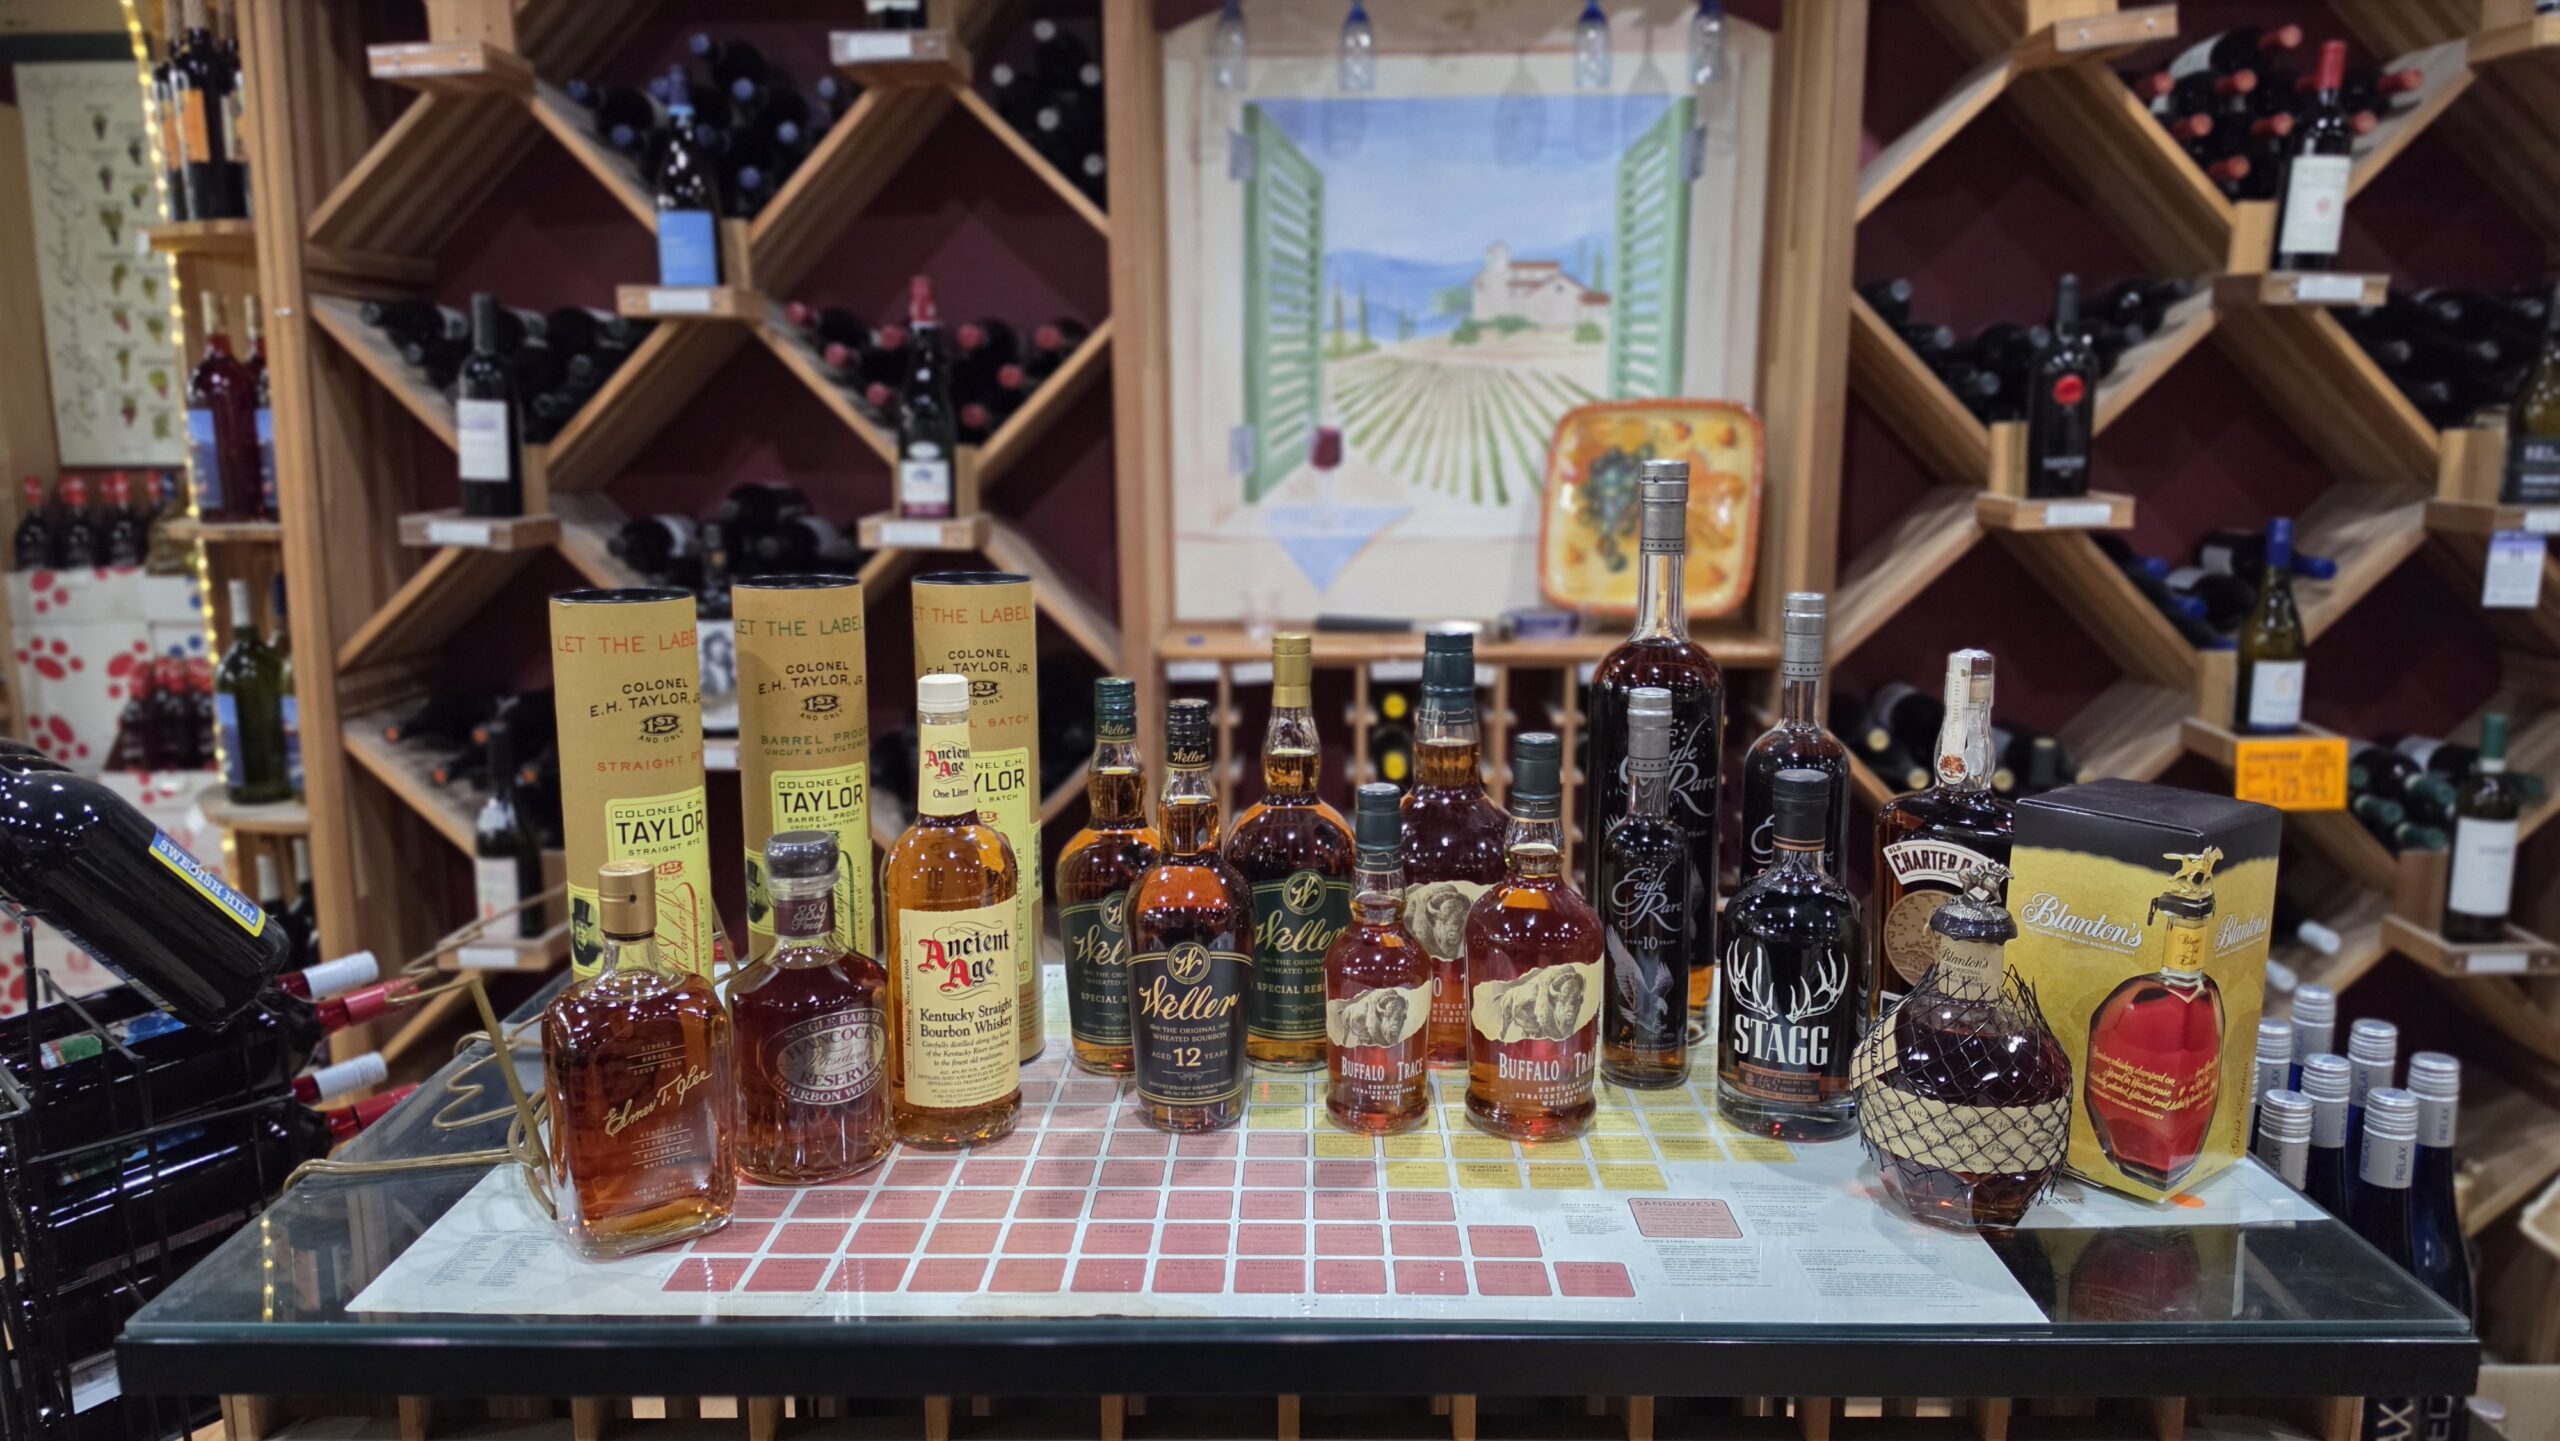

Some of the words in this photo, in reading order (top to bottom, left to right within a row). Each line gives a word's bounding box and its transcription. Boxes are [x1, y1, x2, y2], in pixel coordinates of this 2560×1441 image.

[932, 607, 968, 624] THE
[980, 606, 1030, 623] LABEL
[766, 620, 807, 637] THE
[557, 635, 585, 653] LET
[598, 635, 645, 654] THE
[948, 649, 1011, 660] COLONEL
[785, 661, 849, 675] COLONEL
[953, 661, 1012, 674] TAYLOR,
[621, 678, 689, 695] COLONEL
[758, 680, 786, 695] E.H.
[791, 674, 851, 688] TAYLOR,
[590, 701, 622, 717] E.H.
[628, 692, 691, 709] TAYLOR,
[983, 695, 1003, 706] ONLY
[800, 712, 818, 721] AND
[823, 709, 843, 721] ONLY
[988, 715, 1029, 728] BATCH
[1100, 720, 1131, 735] Weller
[638, 735, 659, 744] AND
[663, 729, 684, 743] ONLY
[761, 735, 824, 746] BARREL
[765, 747, 800, 756] UNCUT
[805, 748, 812, 756] &
[925, 746, 970, 769] Ancient
[1172, 746, 1206, 763] Weller
[597, 755, 683, 772] STRAIGHT
[935, 761, 964, 780] Age
[1004, 759, 1024, 769] E.H.
[778, 778, 840, 789] COLONEL
[974, 768, 1025, 793] YLOR
[779, 784, 864, 813] TAYLOR
[933, 789, 949, 798] One
[952, 788, 968, 798] Liter
[989, 794, 1018, 803] BATCH
[615, 804, 683, 819] COLONEL
[788, 815, 827, 824] BARREL
[834, 809, 860, 819] PROOF
[616, 809, 704, 845] TAYLOR
[628, 843, 681, 857] STRAIGHT
[687, 837, 700, 847] RYE
[1887, 845, 1902, 854] OLD
[158, 839, 224, 897] SWEDISH
[223, 890, 257, 925] HILL
[1612, 859, 1675, 916] Eagle
[1619, 892, 1684, 932] Rare
[2020, 892, 2143, 948] Blanton's
[1255, 910, 1349, 953] Weller
[2214, 910, 2268, 951] Blanton's
[917, 928, 1009, 973] Ancient
[1643, 936, 1658, 950] 10
[1174, 946, 1203, 977] W
[1293, 958, 1325, 966] ORIGIN
[1942, 947, 1990, 969] Blanton's
[940, 958, 995, 993] Age
[1264, 967, 1303, 975] WHEATED
[1257, 982, 1301, 995] SPECIAL
[1081, 991, 1119, 1004] SPECIAL
[1138, 975, 1241, 1021] Weller
[920, 1008, 975, 1023] Kentucky
[978, 997, 1013, 1018] Straight
[784, 1017, 838, 1041] SINGLE
[920, 1024, 970, 1038] Bourbon
[974, 1015, 1013, 1034] Whiskey
[1162, 1026, 1177, 1034] THE
[1179, 1025, 1217, 1034] ORIGINAL
[641, 1040, 671, 1051] SINGLE
[921, 1040, 949, 1049] Carefully
[950, 1039, 974, 1048] distilled
[1152, 1033, 1190, 1043] WHEATED
[1191, 1032, 1228, 1043] BOURBON
[1733, 1014, 1829, 1066] STAGG
[641, 1052, 673, 1063] BARREL
[933, 1049, 941, 1057] the
[943, 1049, 971, 1058] Kentucky
[1151, 1051, 1172, 1061] AGED
[1173, 1047, 1202, 1068] 12
[1204, 1050, 1229, 1060] YEARS
[800, 1059, 873, 1087] RESERVE
[1341, 1056, 1385, 1082] BUFFALO
[1397, 1057, 1423, 1081] TRACE
[1499, 1052, 1560, 1082] BUFFALO
[2134, 1065, 2165, 1083] dumped
[774, 1075, 841, 1101] BOURBON
[1538, 1081, 1581, 1093] KENTUCKY
[2131, 1074, 2172, 1097] Warehouse
[2358, 1069, 2369, 1100] RELAX
[1515, 1092, 1562, 1100] STRAIGHT
[1542, 1095, 1578, 1107] WHISKEY
[602, 1098, 657, 1137] Elmer
[656, 1073, 682, 1106] T.
[2137, 1106, 2165, 1121] WHISKEY
[2439, 1107, 2449, 1141] RELAX
[2396, 1145, 2408, 1182] RELAX
[2040, 1196, 2084, 1205] osher
